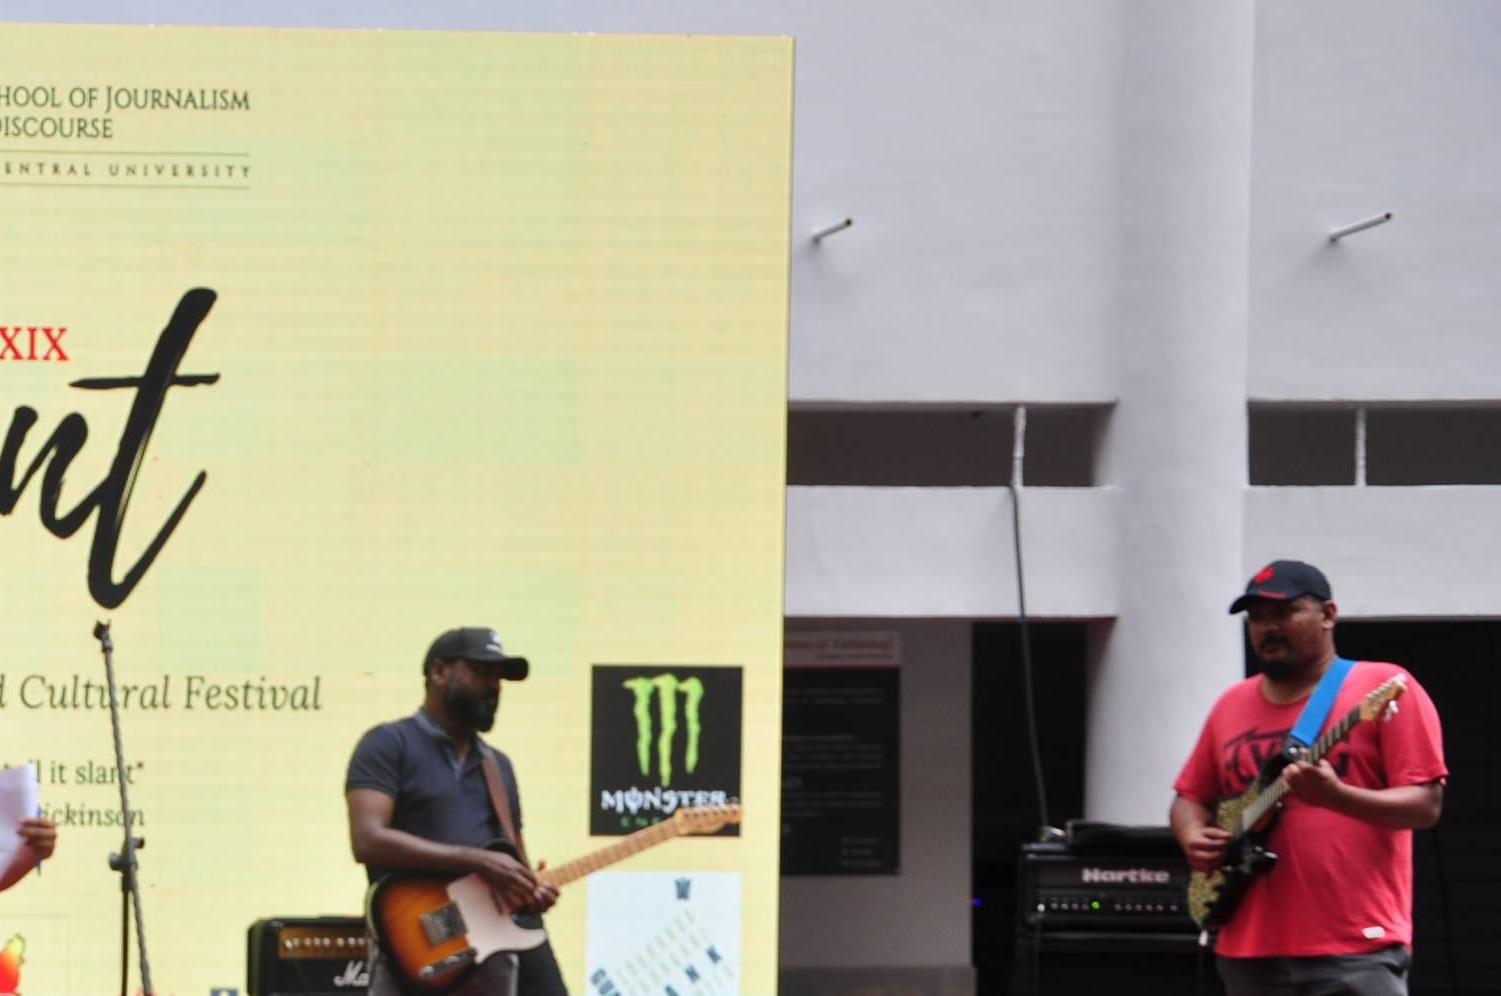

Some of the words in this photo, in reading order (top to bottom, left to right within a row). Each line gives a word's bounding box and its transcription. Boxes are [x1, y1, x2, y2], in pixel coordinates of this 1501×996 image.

[69, 87, 99, 109] OF
[105, 86, 251, 112] JOURNALISM
[109, 164, 251, 179] UNIVERSITY
[184, 674, 323, 710] Festival
[51, 760, 66, 784] it
[1082, 867, 1170, 883] Hartke
